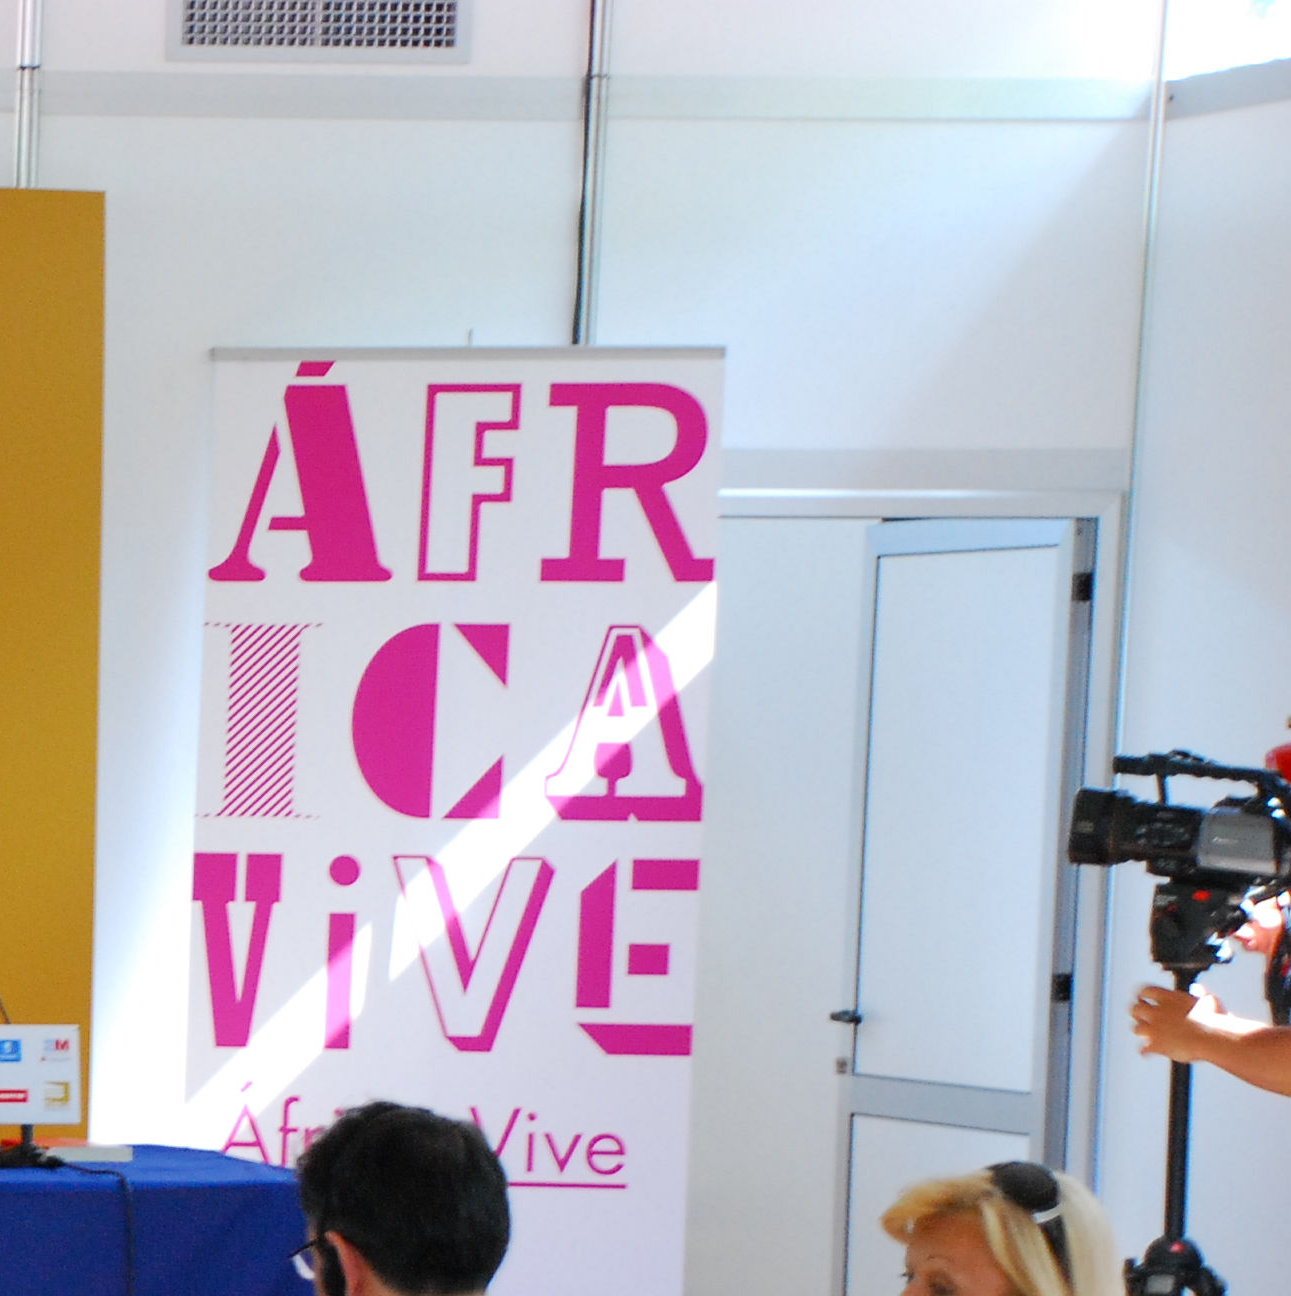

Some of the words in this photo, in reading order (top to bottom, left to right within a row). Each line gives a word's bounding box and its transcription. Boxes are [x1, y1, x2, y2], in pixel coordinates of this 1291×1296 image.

[208, 360, 716, 583] ÁFR
[195, 622, 704, 822] ICA
[469, 1105, 627, 1176] Vive
